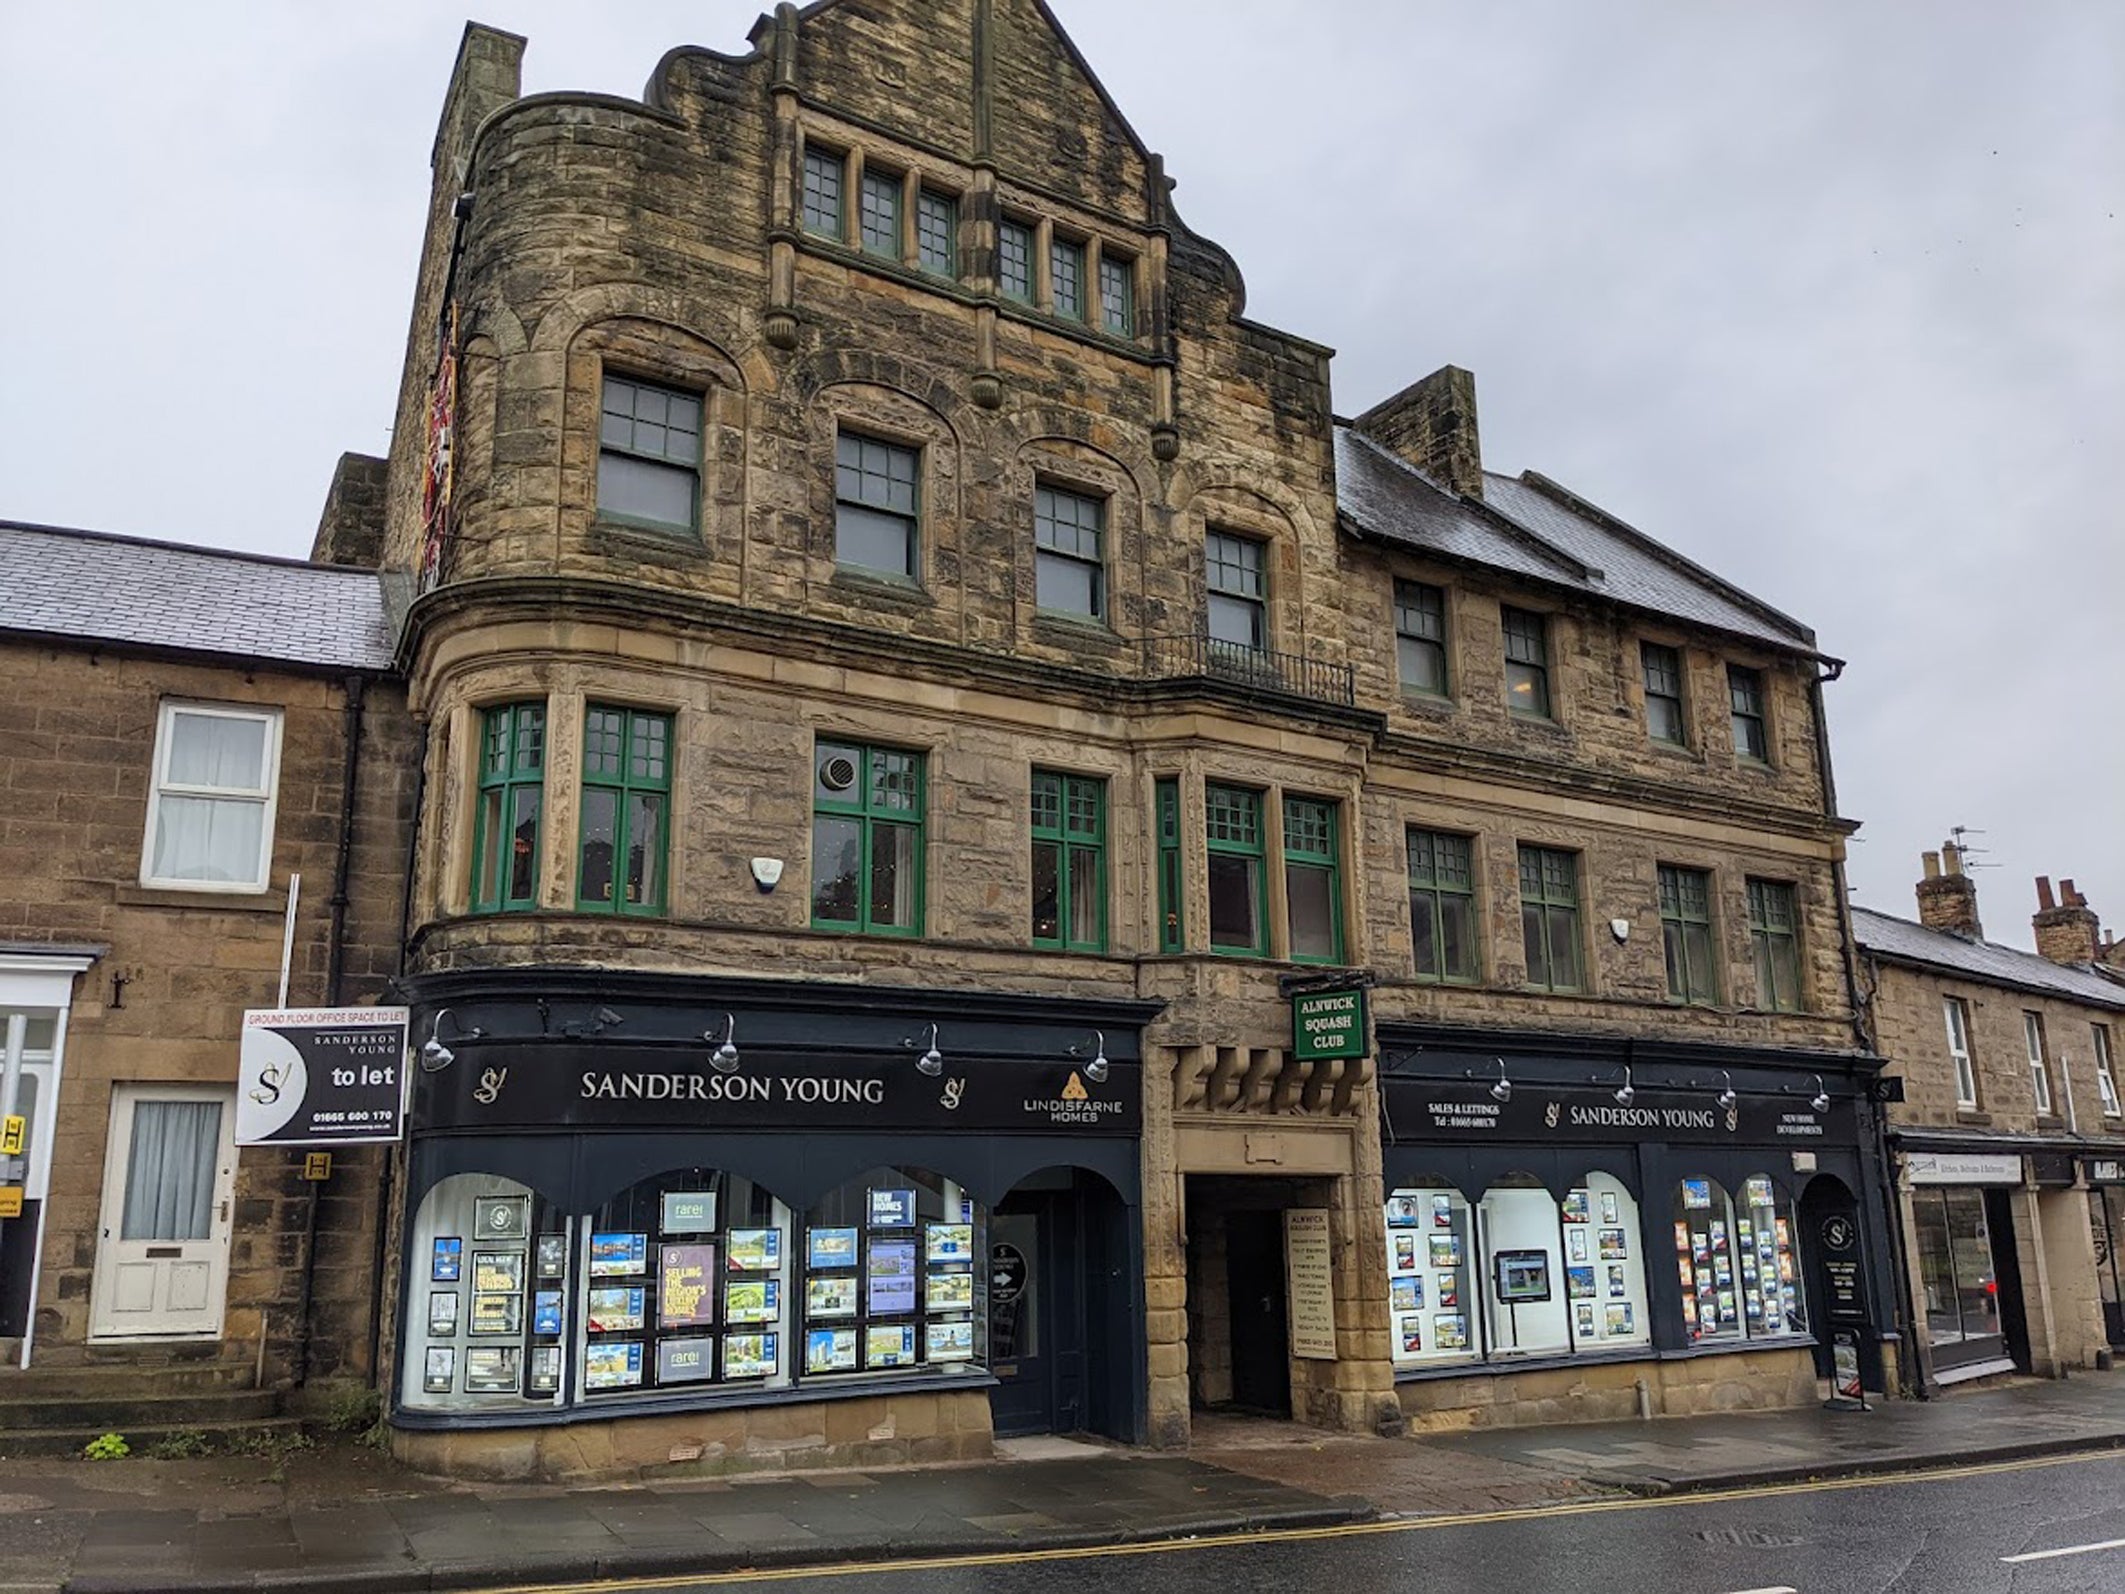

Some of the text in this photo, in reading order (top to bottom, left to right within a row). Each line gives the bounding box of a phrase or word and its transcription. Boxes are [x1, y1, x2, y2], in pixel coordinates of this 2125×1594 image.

[1301, 997, 1355, 1014] ALNWICK
[249, 1011, 405, 1025] GROUND FLOOR OFFICE SPACE TO LET
[1305, 1015, 1352, 1033] SQUASH
[314, 1035, 396, 1045] SANDERSON
[1313, 1034, 1345, 1049] CLUB
[349, 1045, 396, 1055] YOUNG
[331, 1065, 395, 1086] to let
[581, 1072, 884, 1103] SANDERSON YOUNG
[1023, 1099, 1123, 1114] LINDISFARNE
[1428, 1103, 1500, 1115] SALES & LETTINGS
[372, 1110, 393, 1120] 170
[1050, 1112, 1099, 1123] HOMES
[1570, 1106, 1715, 1128] SANDERSON YOUNG
[873, 1201, 902, 1211] HOMES
[665, 1266, 702, 1278] SELLING
